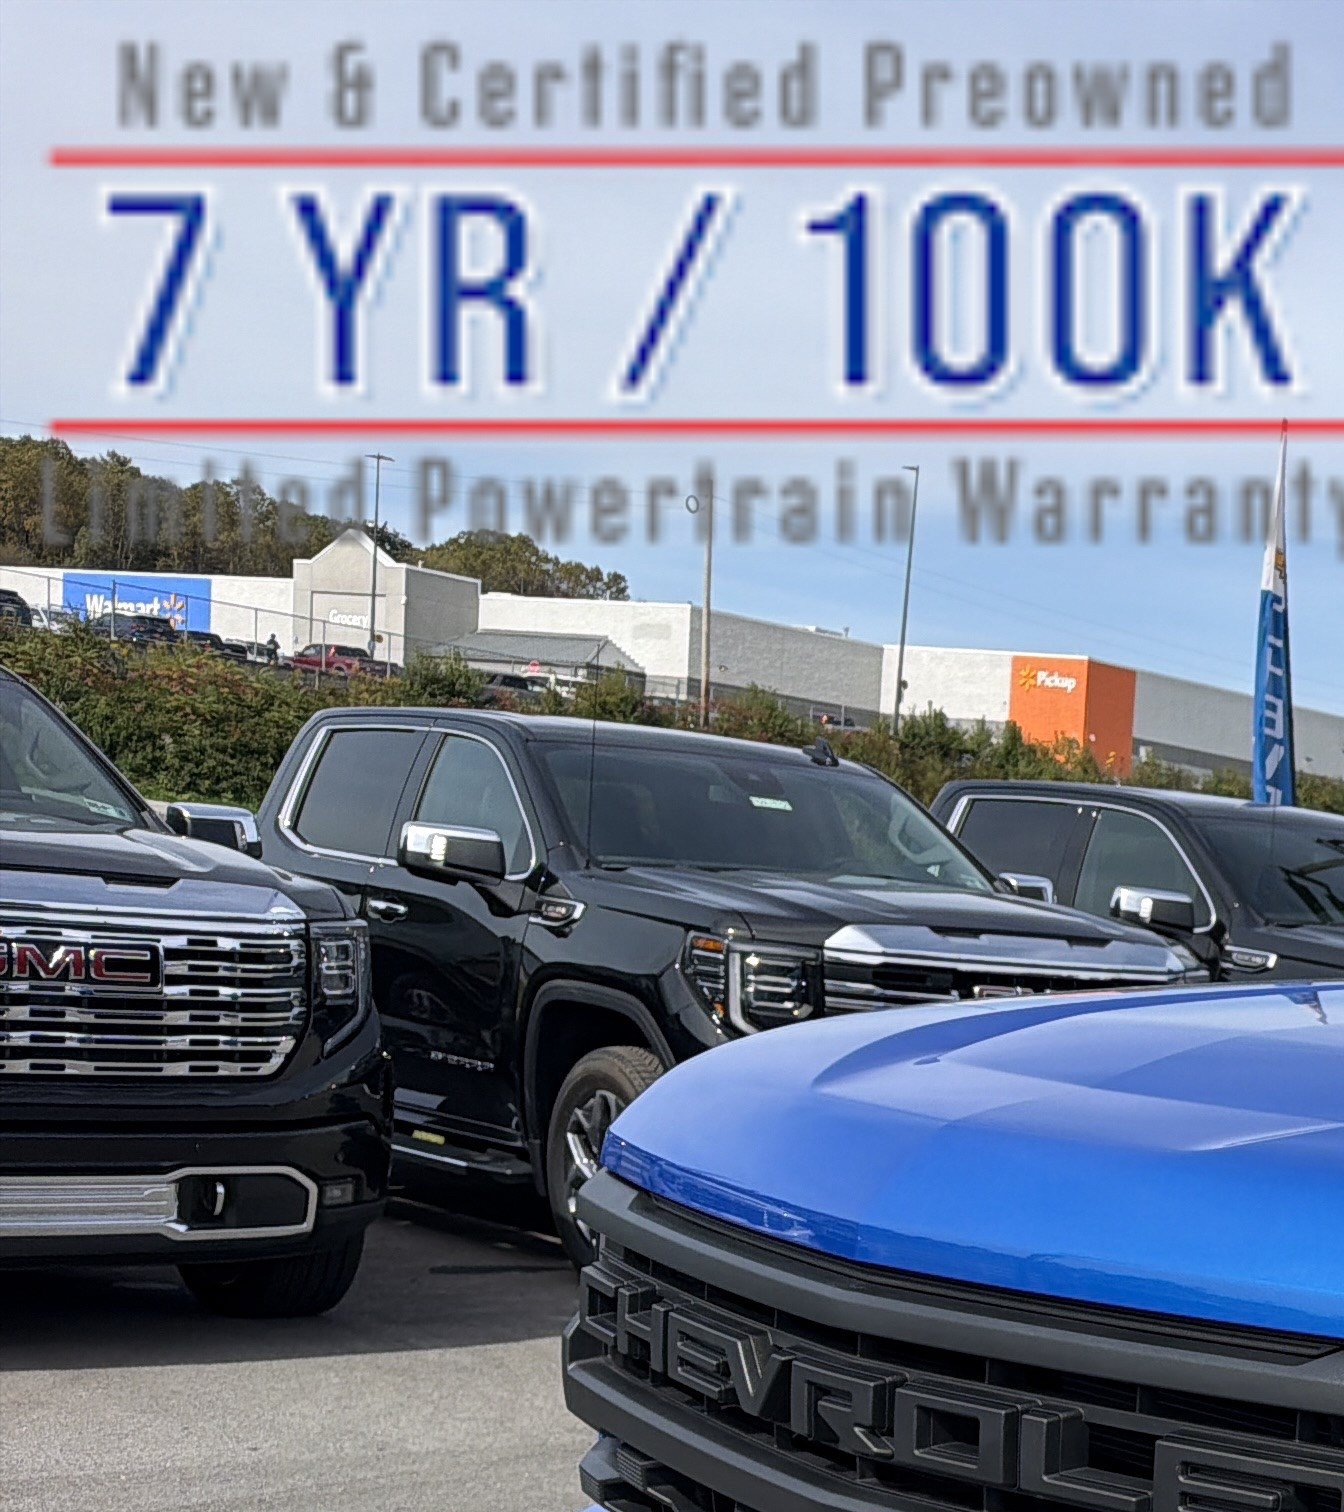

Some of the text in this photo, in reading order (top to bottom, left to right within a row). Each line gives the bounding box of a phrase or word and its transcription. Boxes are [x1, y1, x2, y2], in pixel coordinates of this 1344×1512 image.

[86, 594, 160, 617] Walmart
[1036, 670, 1077, 694] Pickup
[0, 942, 152, 984] MC
